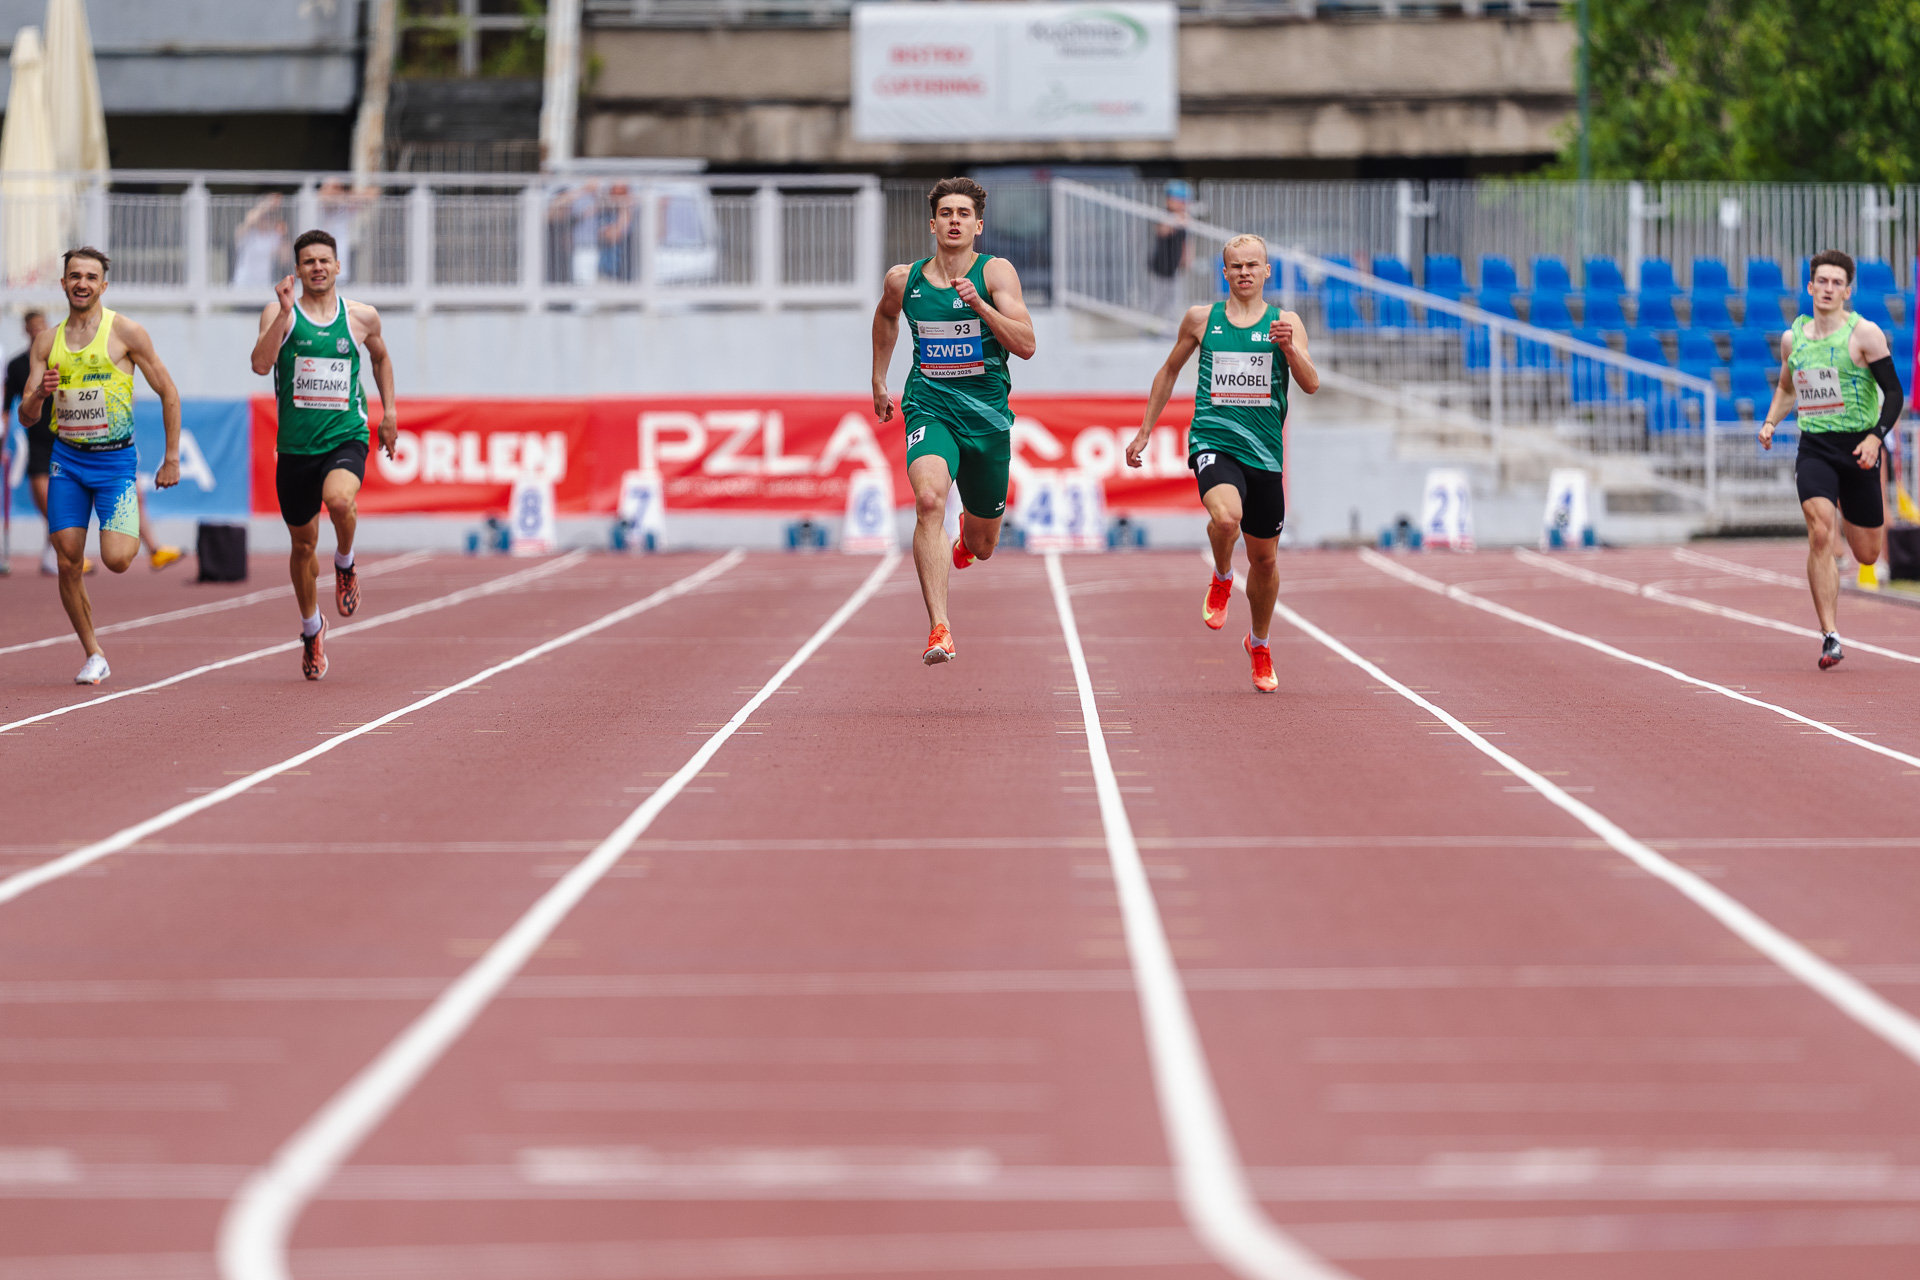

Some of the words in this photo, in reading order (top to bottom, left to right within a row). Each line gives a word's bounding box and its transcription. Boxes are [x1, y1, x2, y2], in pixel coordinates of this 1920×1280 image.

[954, 323, 971, 335] 93
[926, 343, 973, 358] SZWED
[330, 361, 344, 373] 63
[1250, 356, 1264, 367] 95
[1215, 371, 1268, 387] WRÓBEL
[1819, 370, 1832, 380] 84
[296, 376, 348, 392] ŚMIETANKA
[78, 390, 99, 401] 267
[1799, 387, 1837, 400] TATARA
[638, 410, 891, 476] PZLA
[910, 430, 920, 446] 5
[376, 430, 567, 485] ORLEN
[517, 489, 544, 536] 8
[630, 487, 654, 531] 7
[855, 487, 884, 529] 6
[1026, 486, 1055, 529] 4
[1430, 485, 1449, 532] 2
